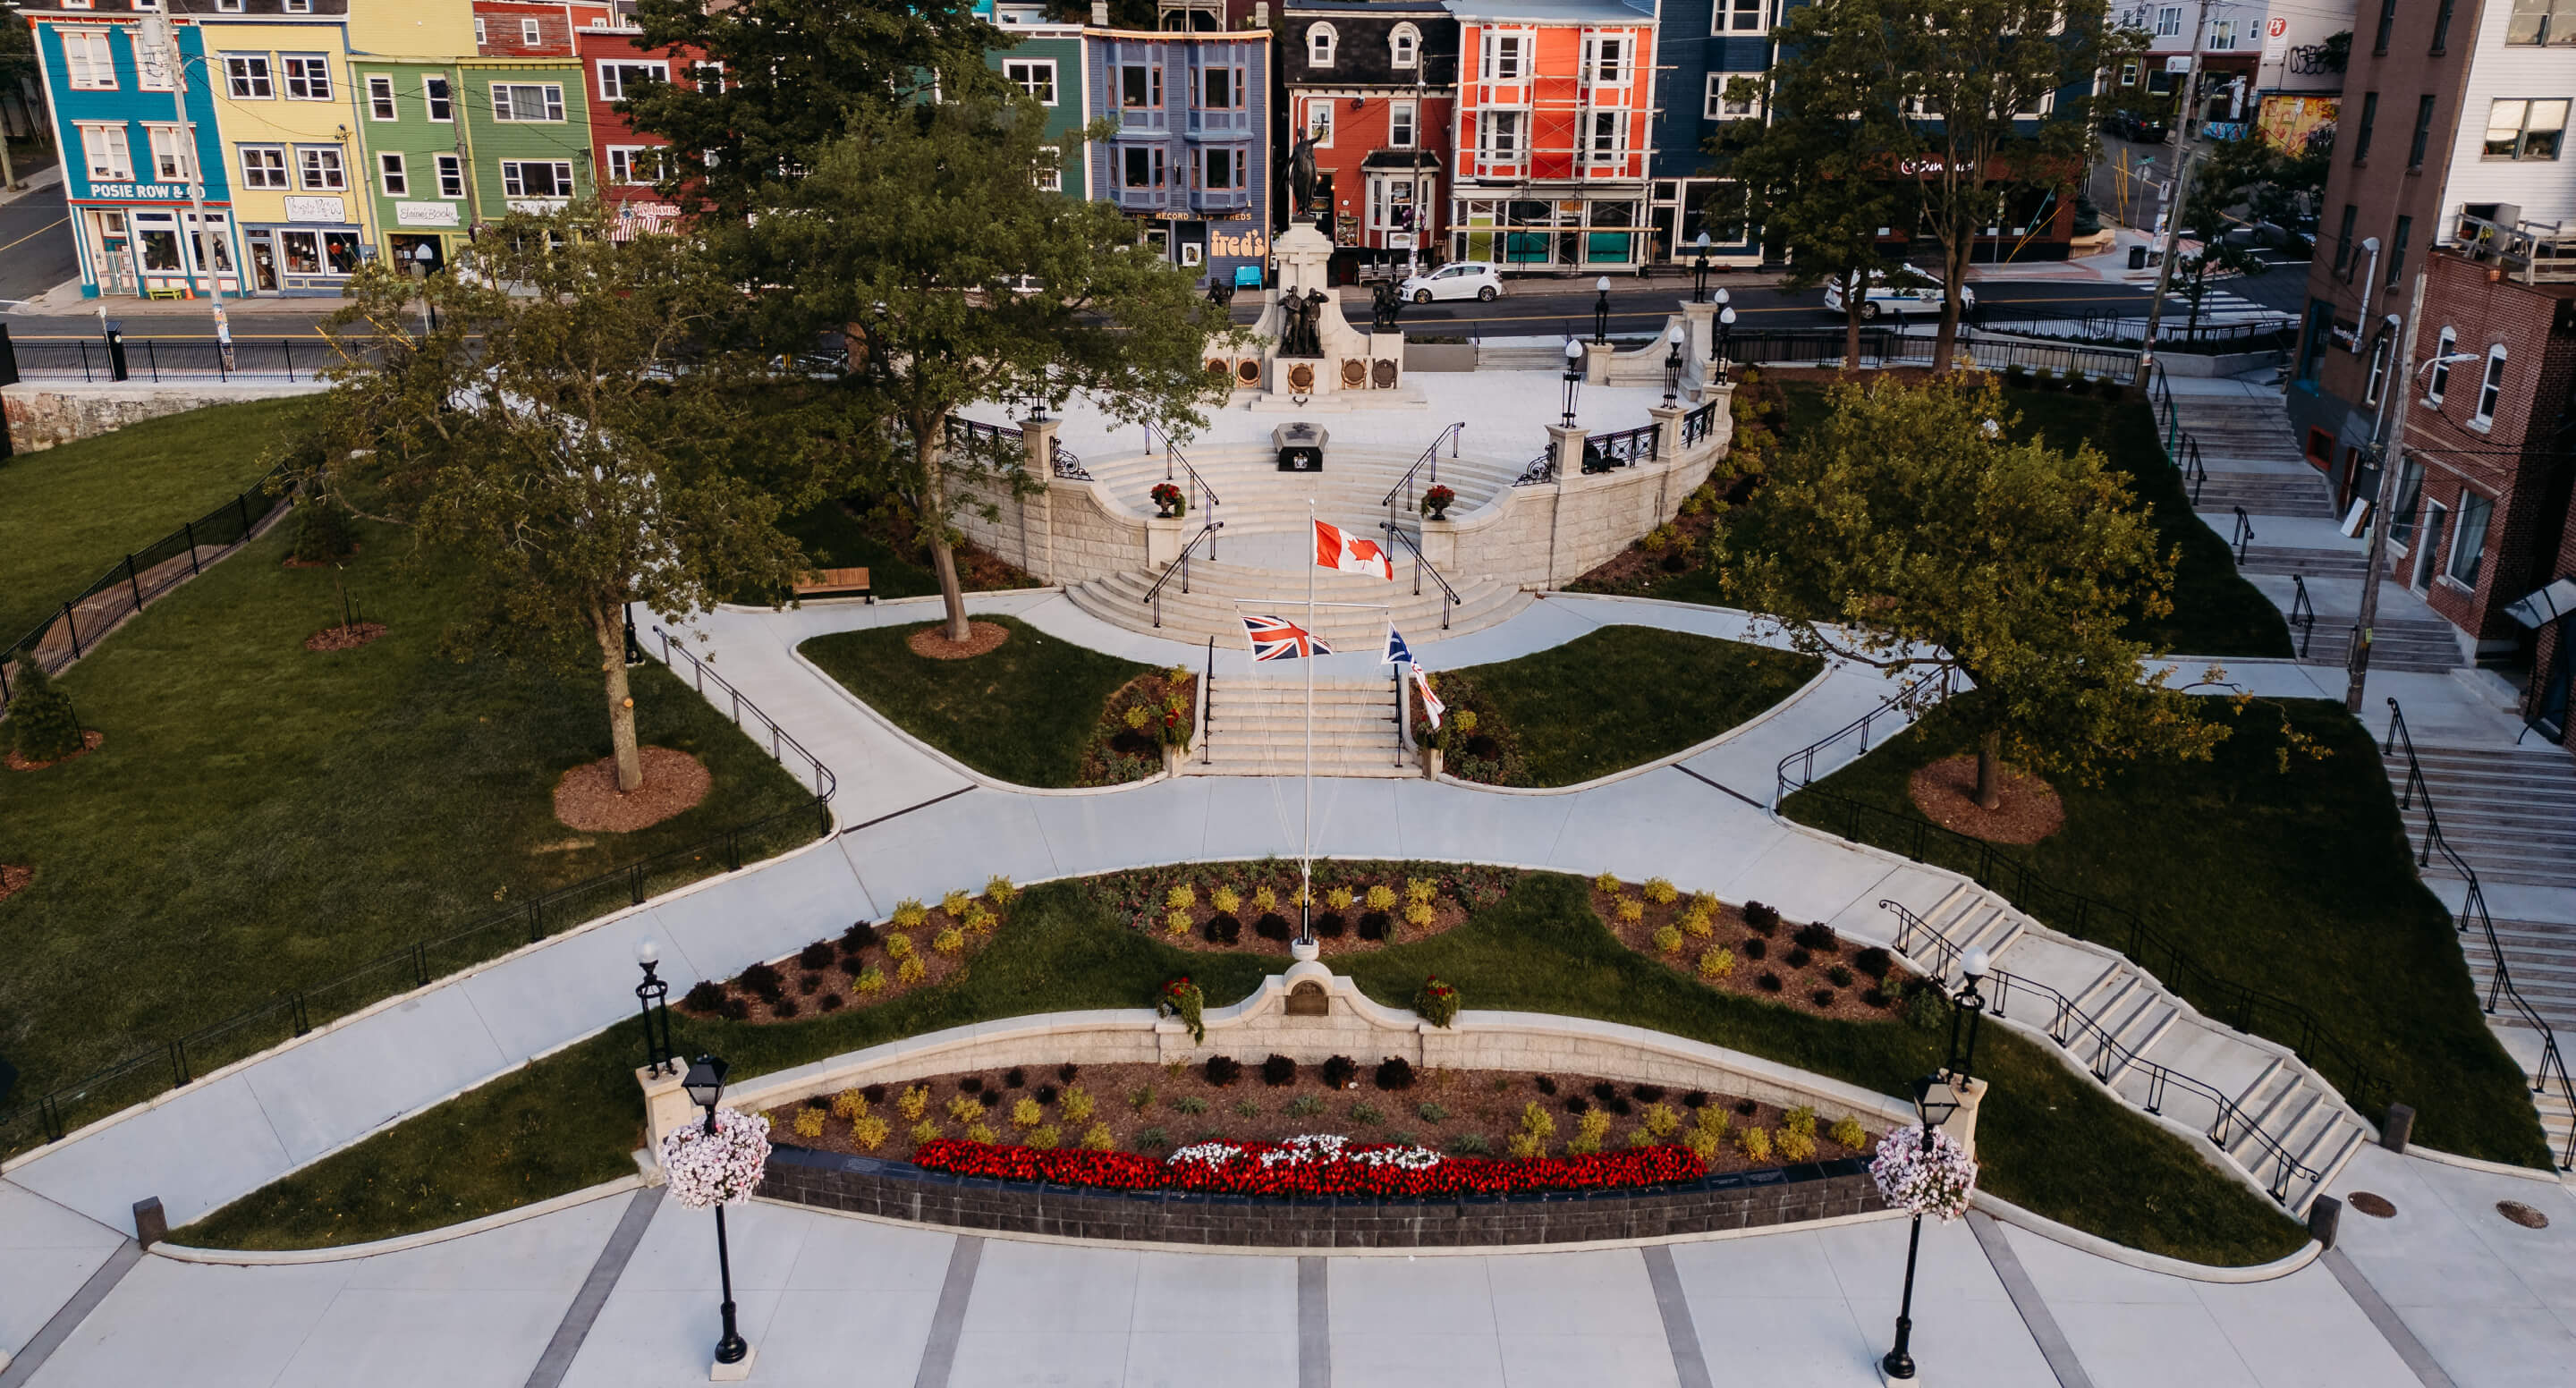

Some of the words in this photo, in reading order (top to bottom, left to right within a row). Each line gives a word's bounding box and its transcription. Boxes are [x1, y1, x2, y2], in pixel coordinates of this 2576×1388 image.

[90, 184, 133, 198] POSIE
[136, 185, 169, 198] ROW
[173, 186, 183, 199] &
[1156, 211, 1189, 221] RECORD
[1223, 212, 1252, 222] FREDS
[1210, 229, 1265, 257] fred's
